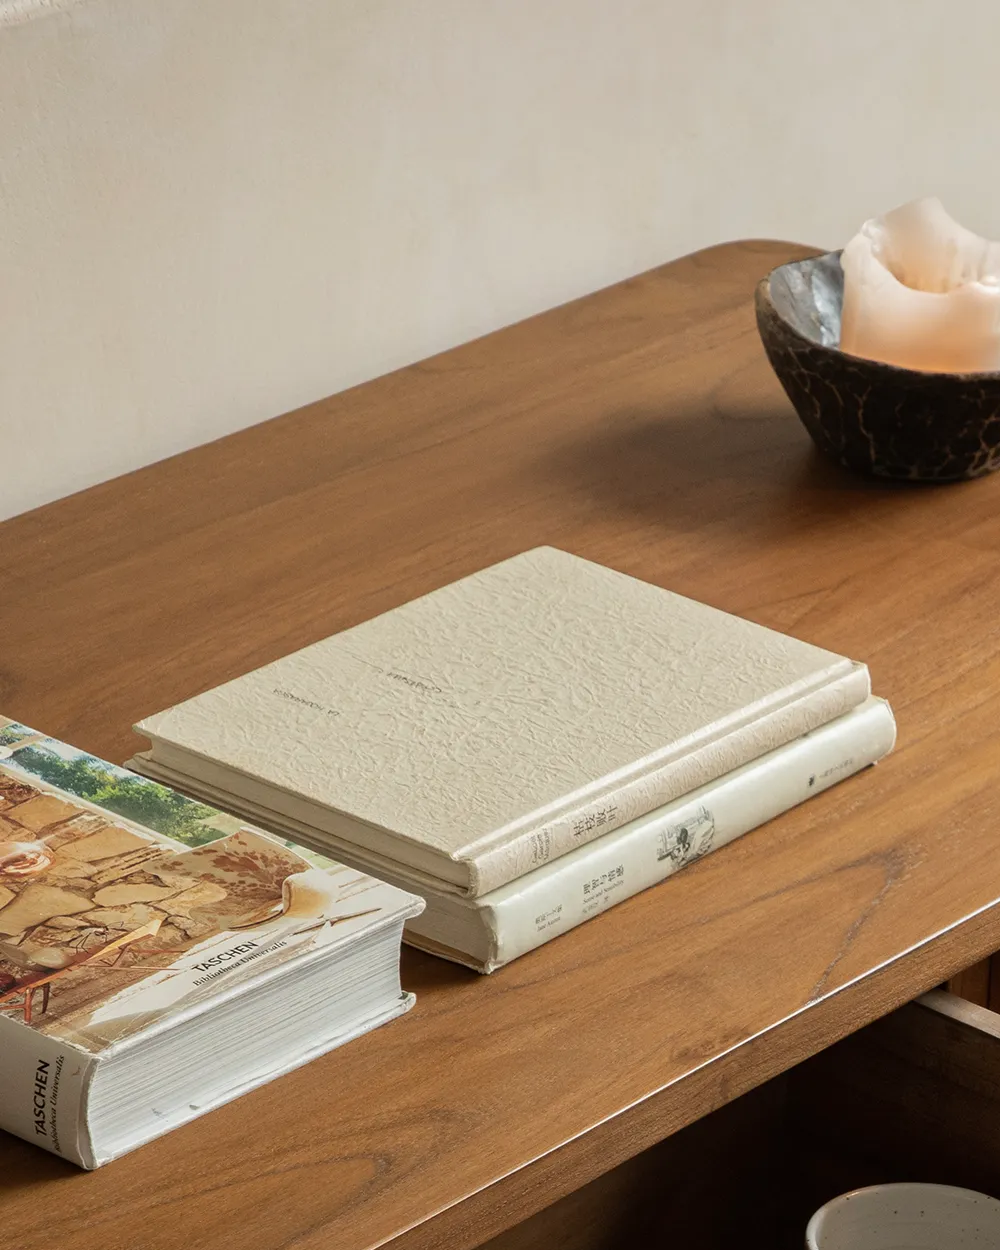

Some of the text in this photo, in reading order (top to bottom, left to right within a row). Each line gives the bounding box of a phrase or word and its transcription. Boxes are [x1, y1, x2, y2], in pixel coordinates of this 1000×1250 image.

[573, 804, 618, 837] 枯枝败叶
[583, 864, 624, 895] 理智与情感
[191, 940, 259, 972] TASCHEN
[193, 940, 288, 987] Bibliotheca Universalis
[33, 1059, 50, 1136] TASCHEN
[49, 1055, 65, 1106] Universalis
